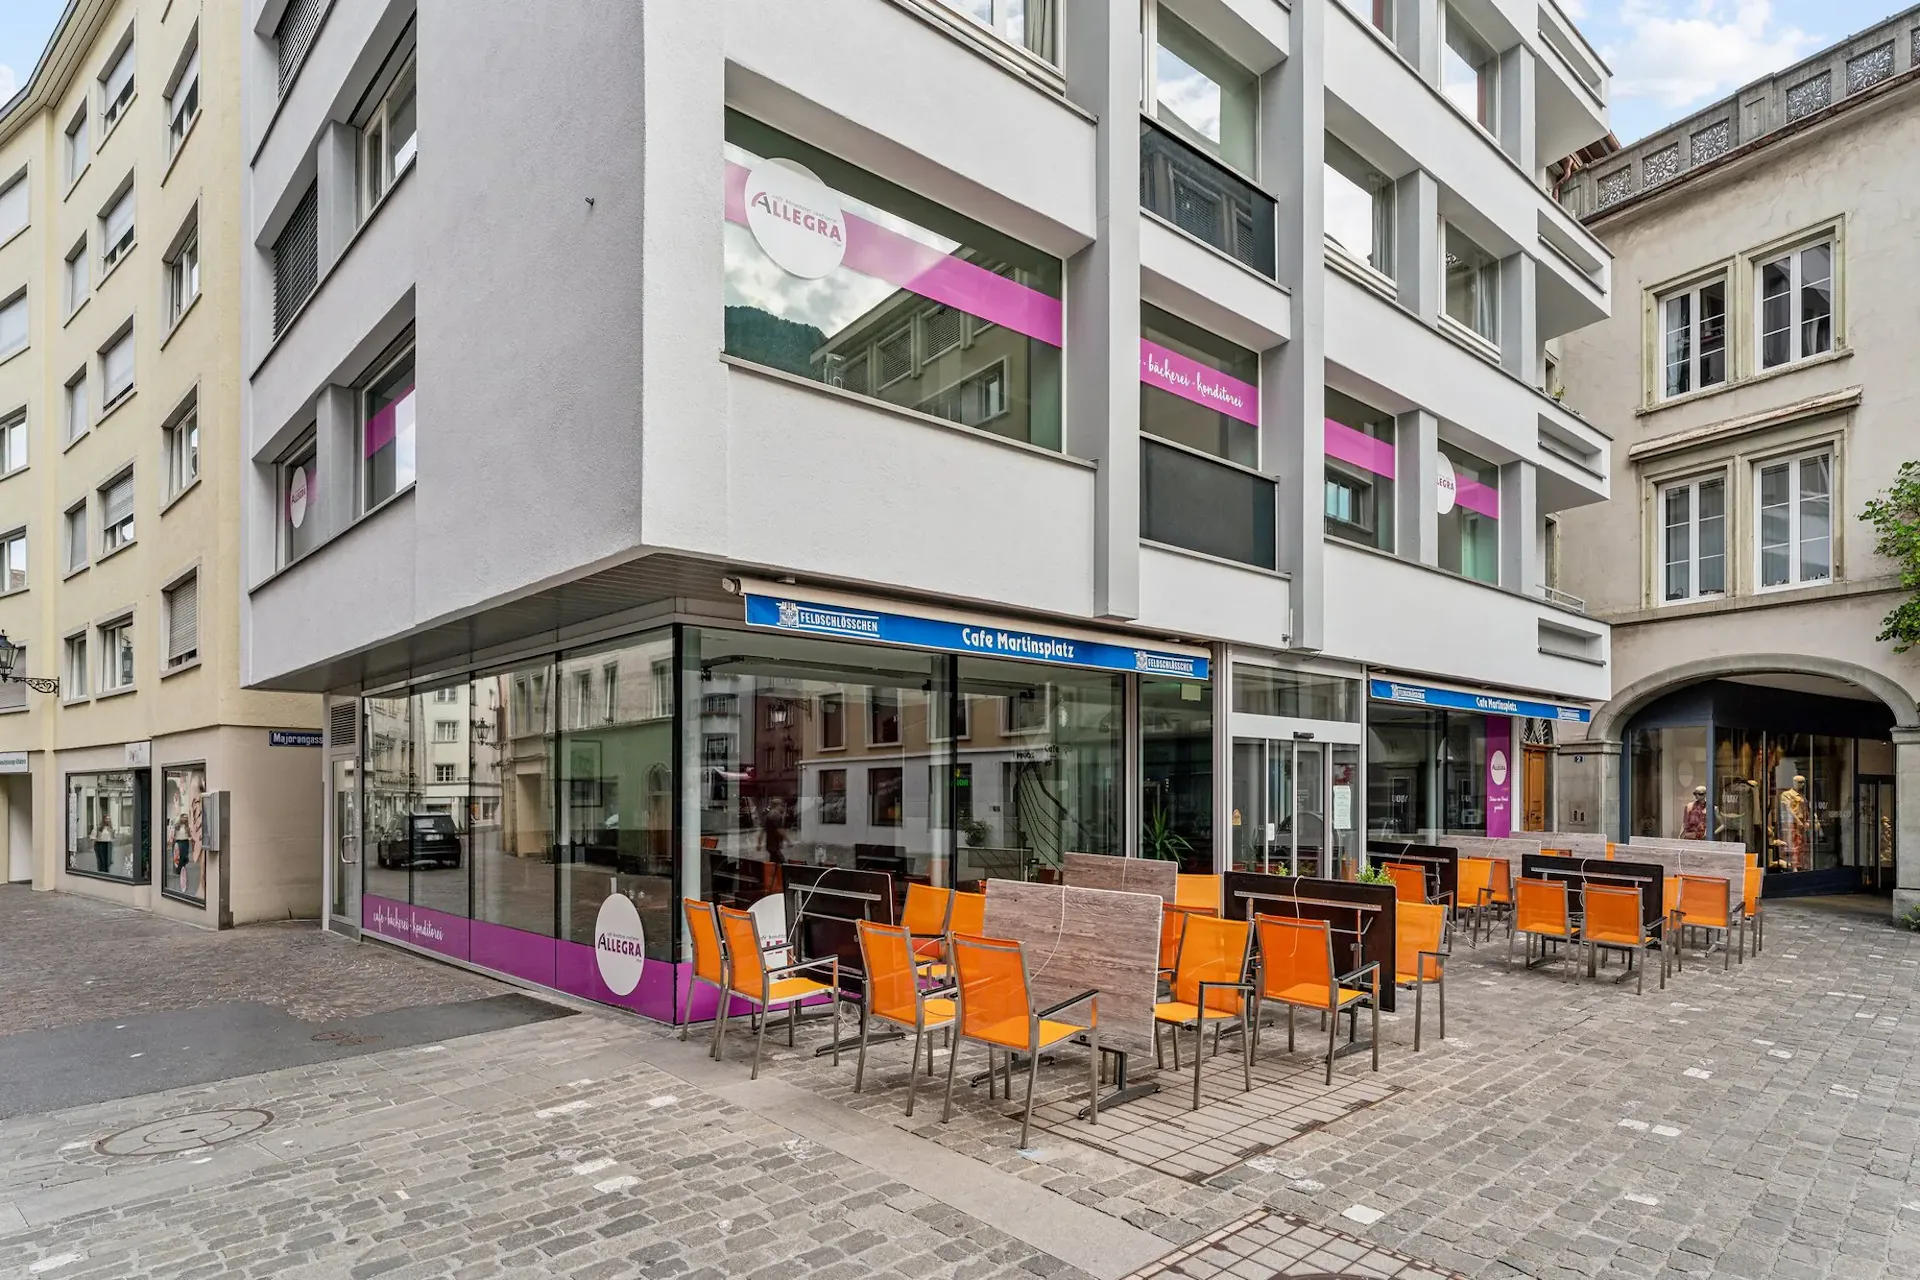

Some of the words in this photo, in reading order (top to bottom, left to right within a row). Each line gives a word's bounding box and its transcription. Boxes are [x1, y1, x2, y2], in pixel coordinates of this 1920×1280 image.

[751, 192, 841, 242] ALLEGRA
[1149, 353, 1191, 387] bäckerei
[1197, 372, 1244, 408] konditorei
[800, 611, 878, 632] FELDSCHLÖSSCHEN
[962, 628, 993, 649] Cafe
[997, 632, 1074, 658] Martinsplatz
[412, 911, 444, 941] konditorei
[598, 932, 642, 958] ALLEGRA
